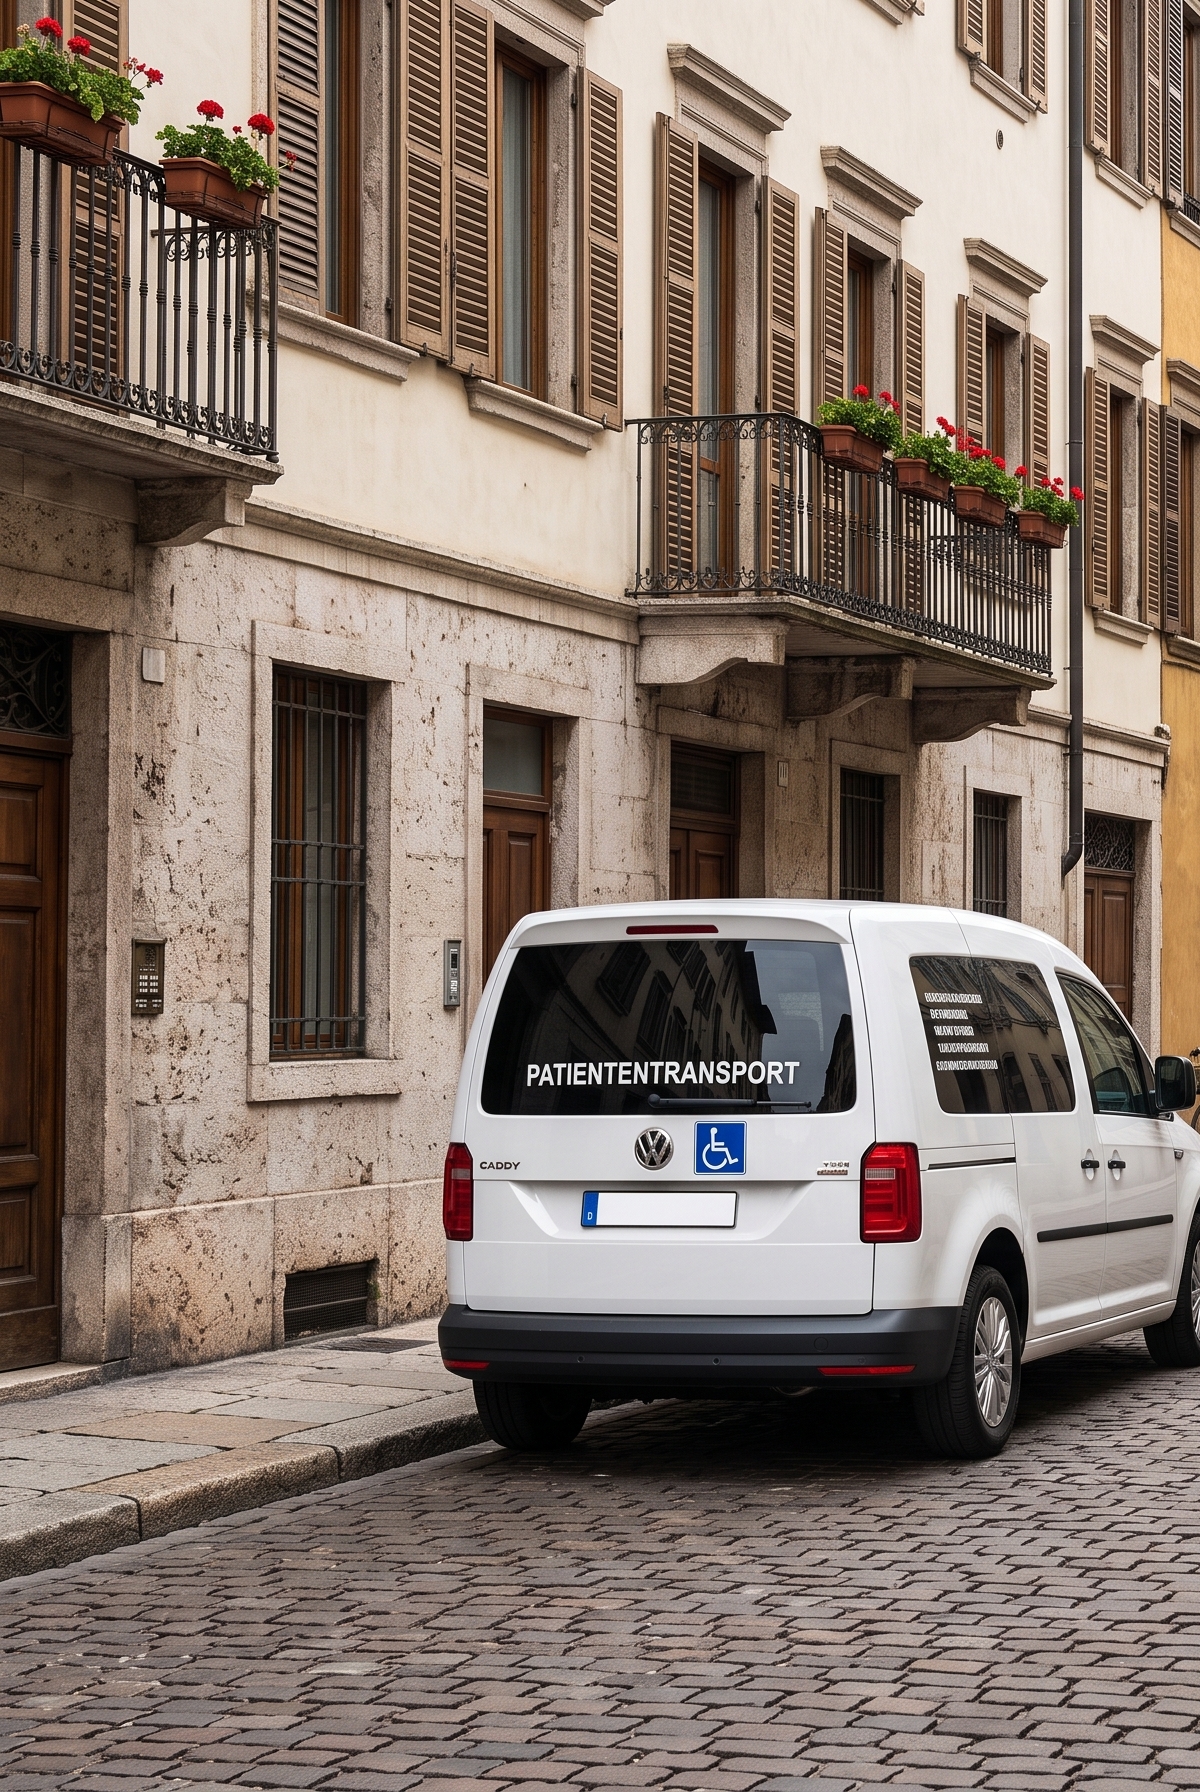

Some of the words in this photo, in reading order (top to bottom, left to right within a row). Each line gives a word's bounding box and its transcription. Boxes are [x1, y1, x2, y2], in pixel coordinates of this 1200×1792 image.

[526, 1061, 800, 1086] PATIENTENTRANSPORT
[480, 1161, 520, 1170] CADDY
[587, 1211, 593, 1220] D
